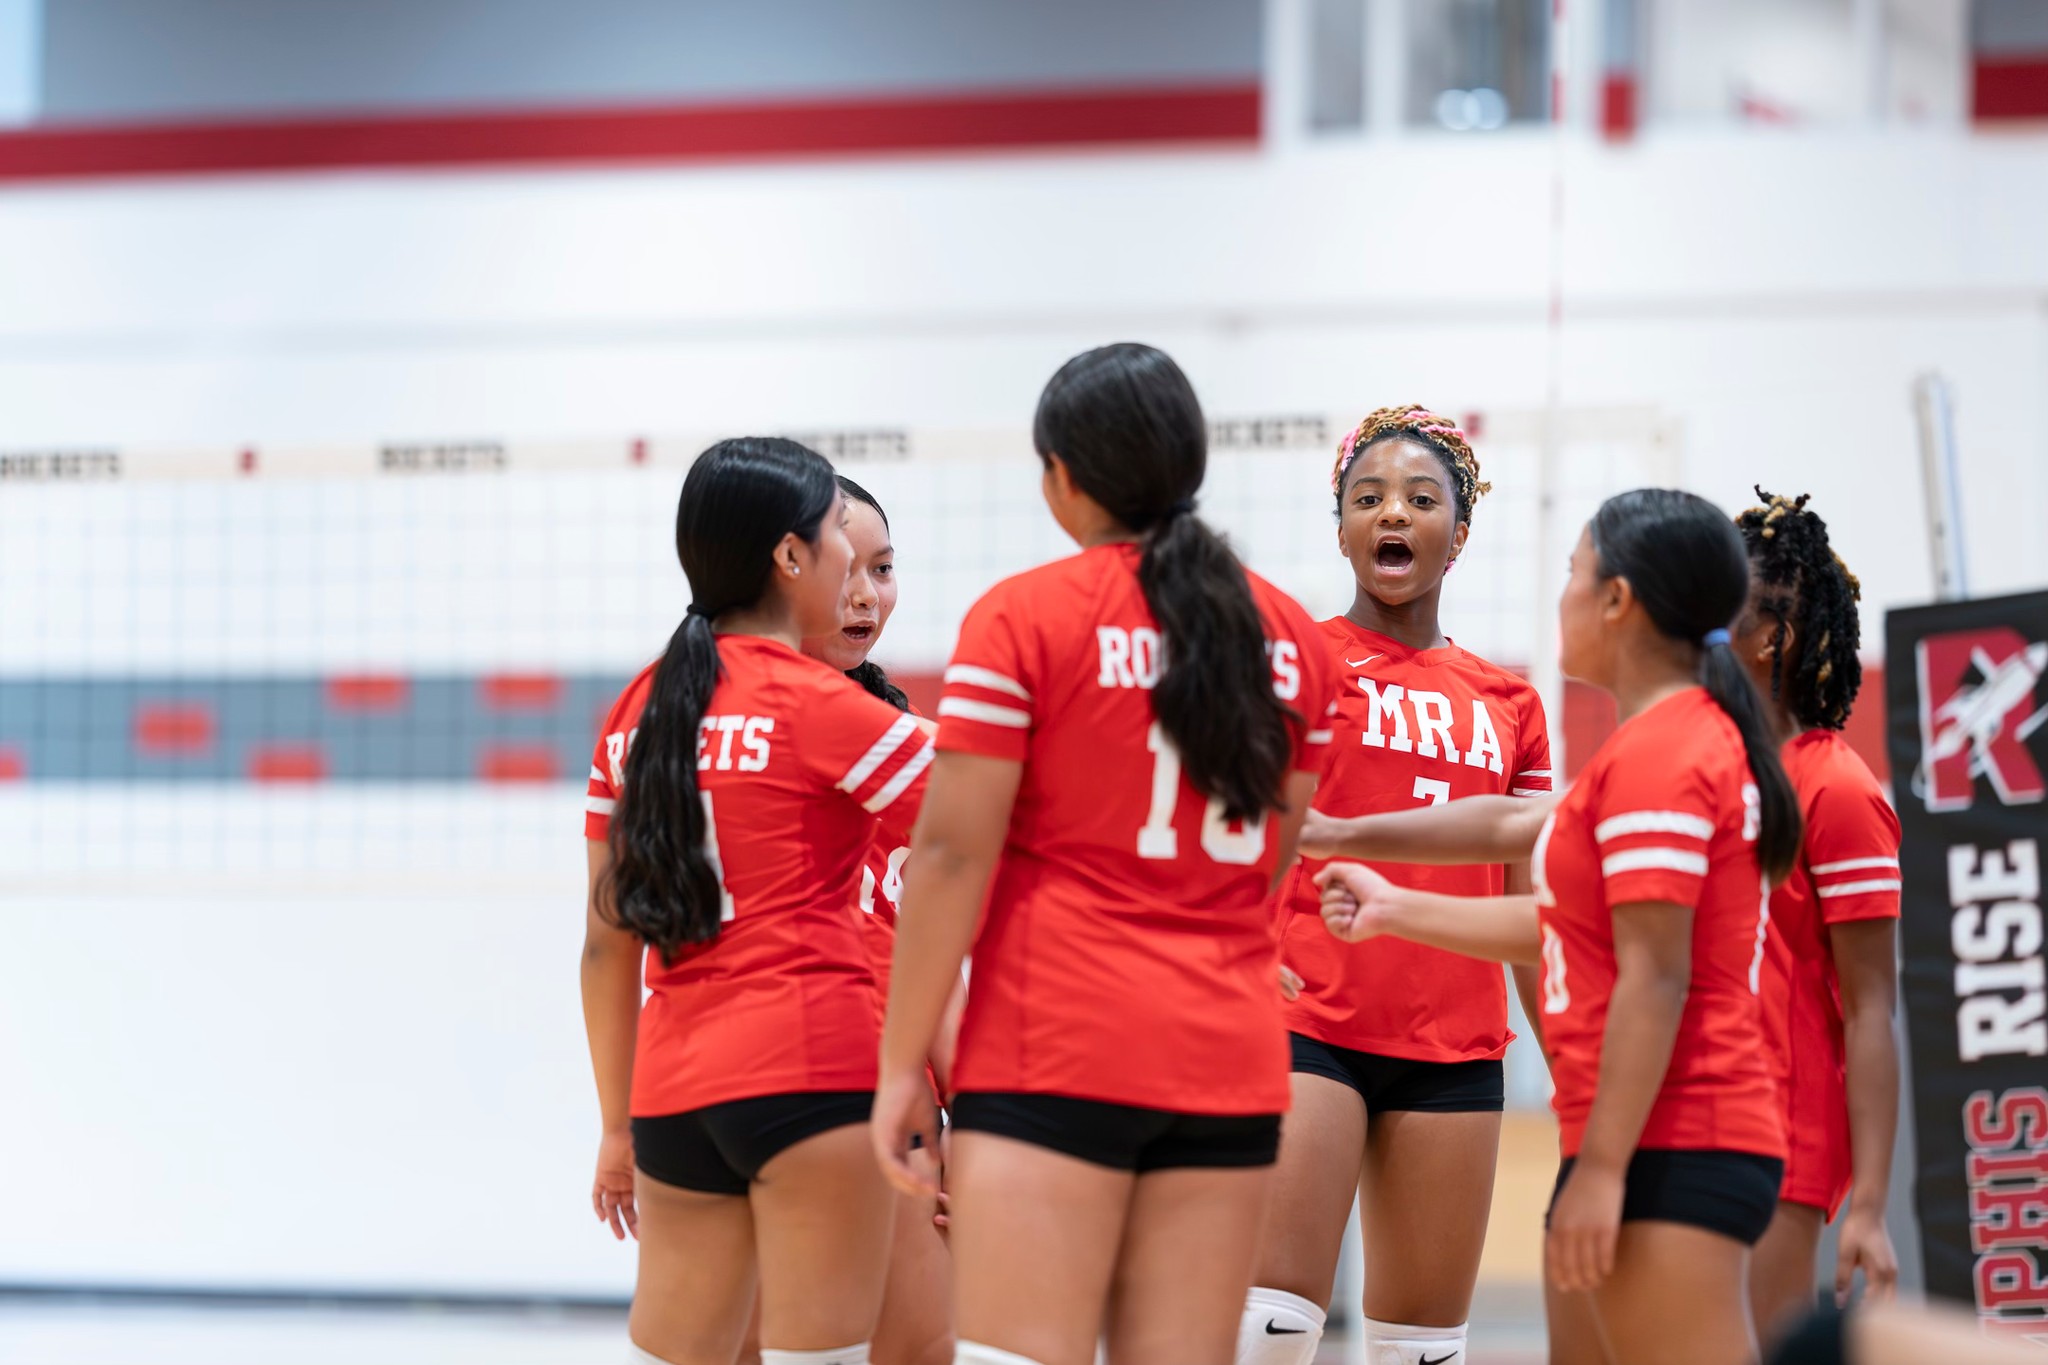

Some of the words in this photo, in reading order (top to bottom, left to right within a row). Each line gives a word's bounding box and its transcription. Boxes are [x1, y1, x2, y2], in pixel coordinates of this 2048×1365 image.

[606, 714, 775, 787] RETS
[1357, 676, 1504, 776] MRA
[1948, 838, 2048, 1062] RISE
[1962, 1086, 2048, 1345] PHIS
